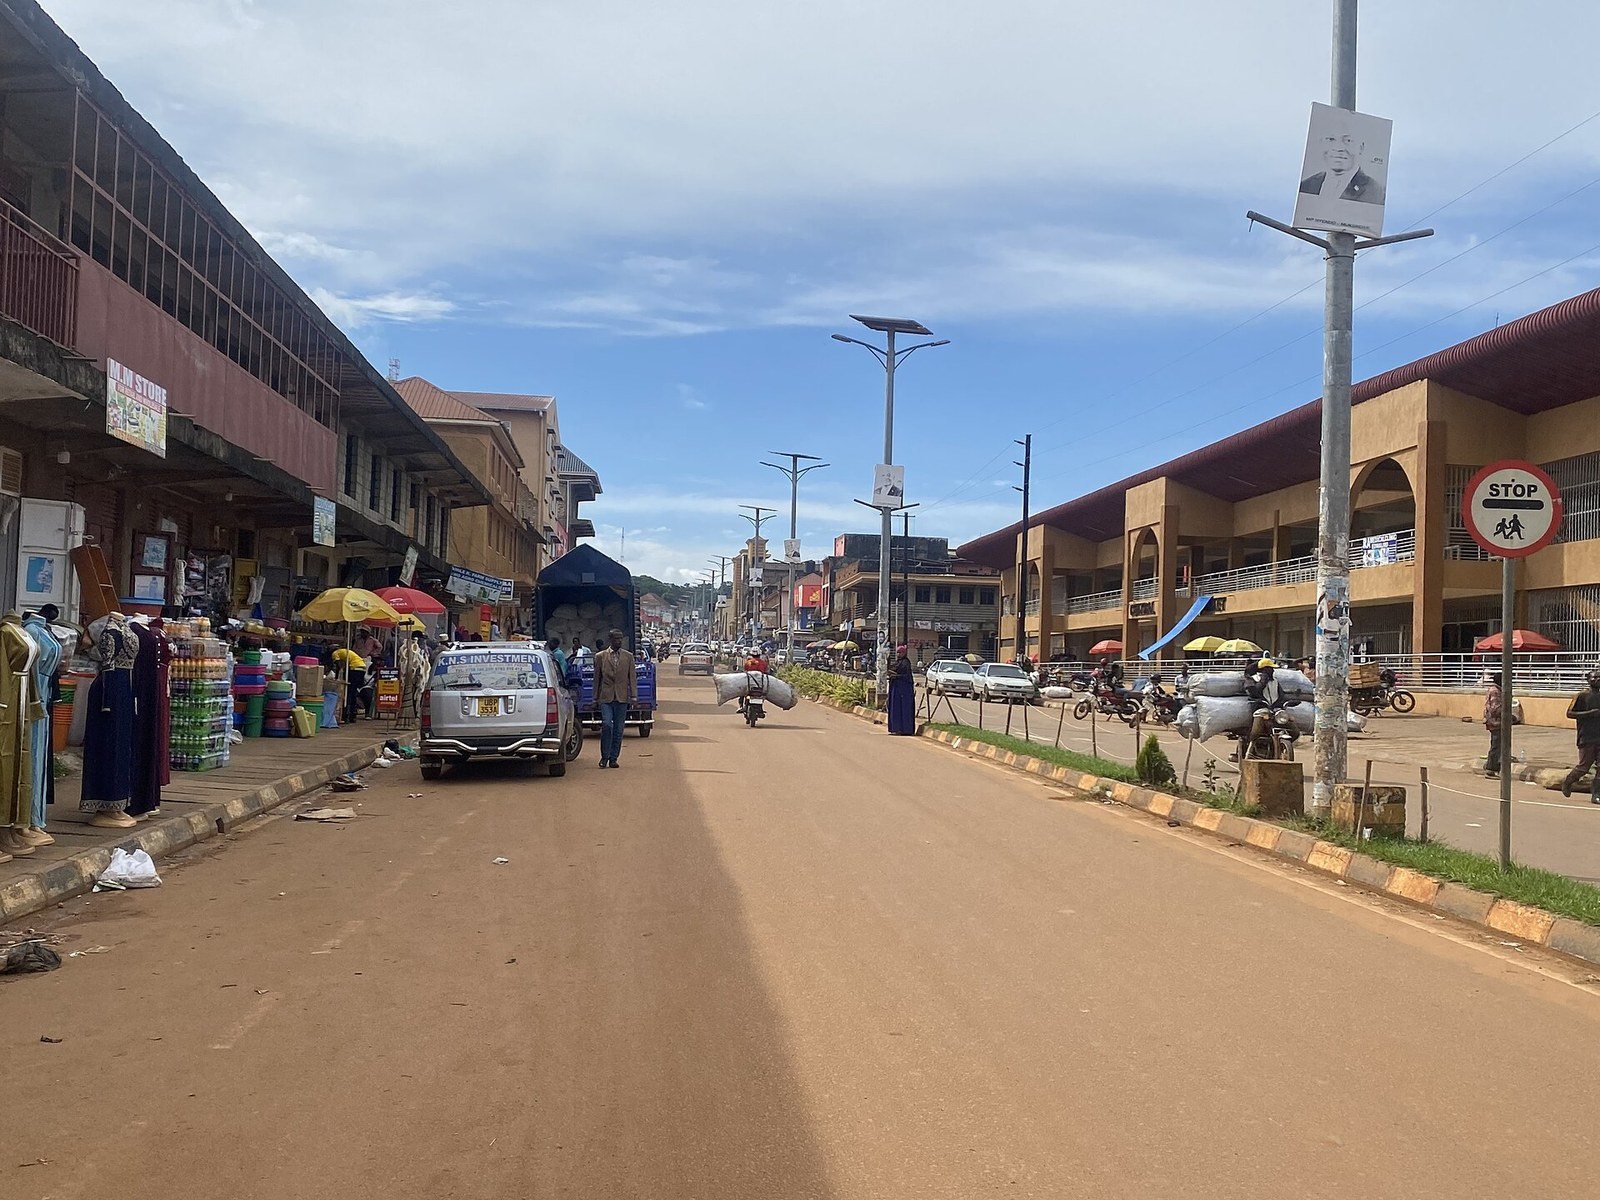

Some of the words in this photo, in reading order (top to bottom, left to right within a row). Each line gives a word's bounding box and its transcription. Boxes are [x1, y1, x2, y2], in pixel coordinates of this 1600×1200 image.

[135, 372, 167, 406] STORE
[1489, 483, 1538, 497] STOP
[485, 577, 502, 585] SUPPLY
[438, 656, 467, 666] K.N.S
[470, 654, 541, 664] INVESTMENT
[483, 698, 498, 707] UBP
[480, 706, 498, 714] 353A
